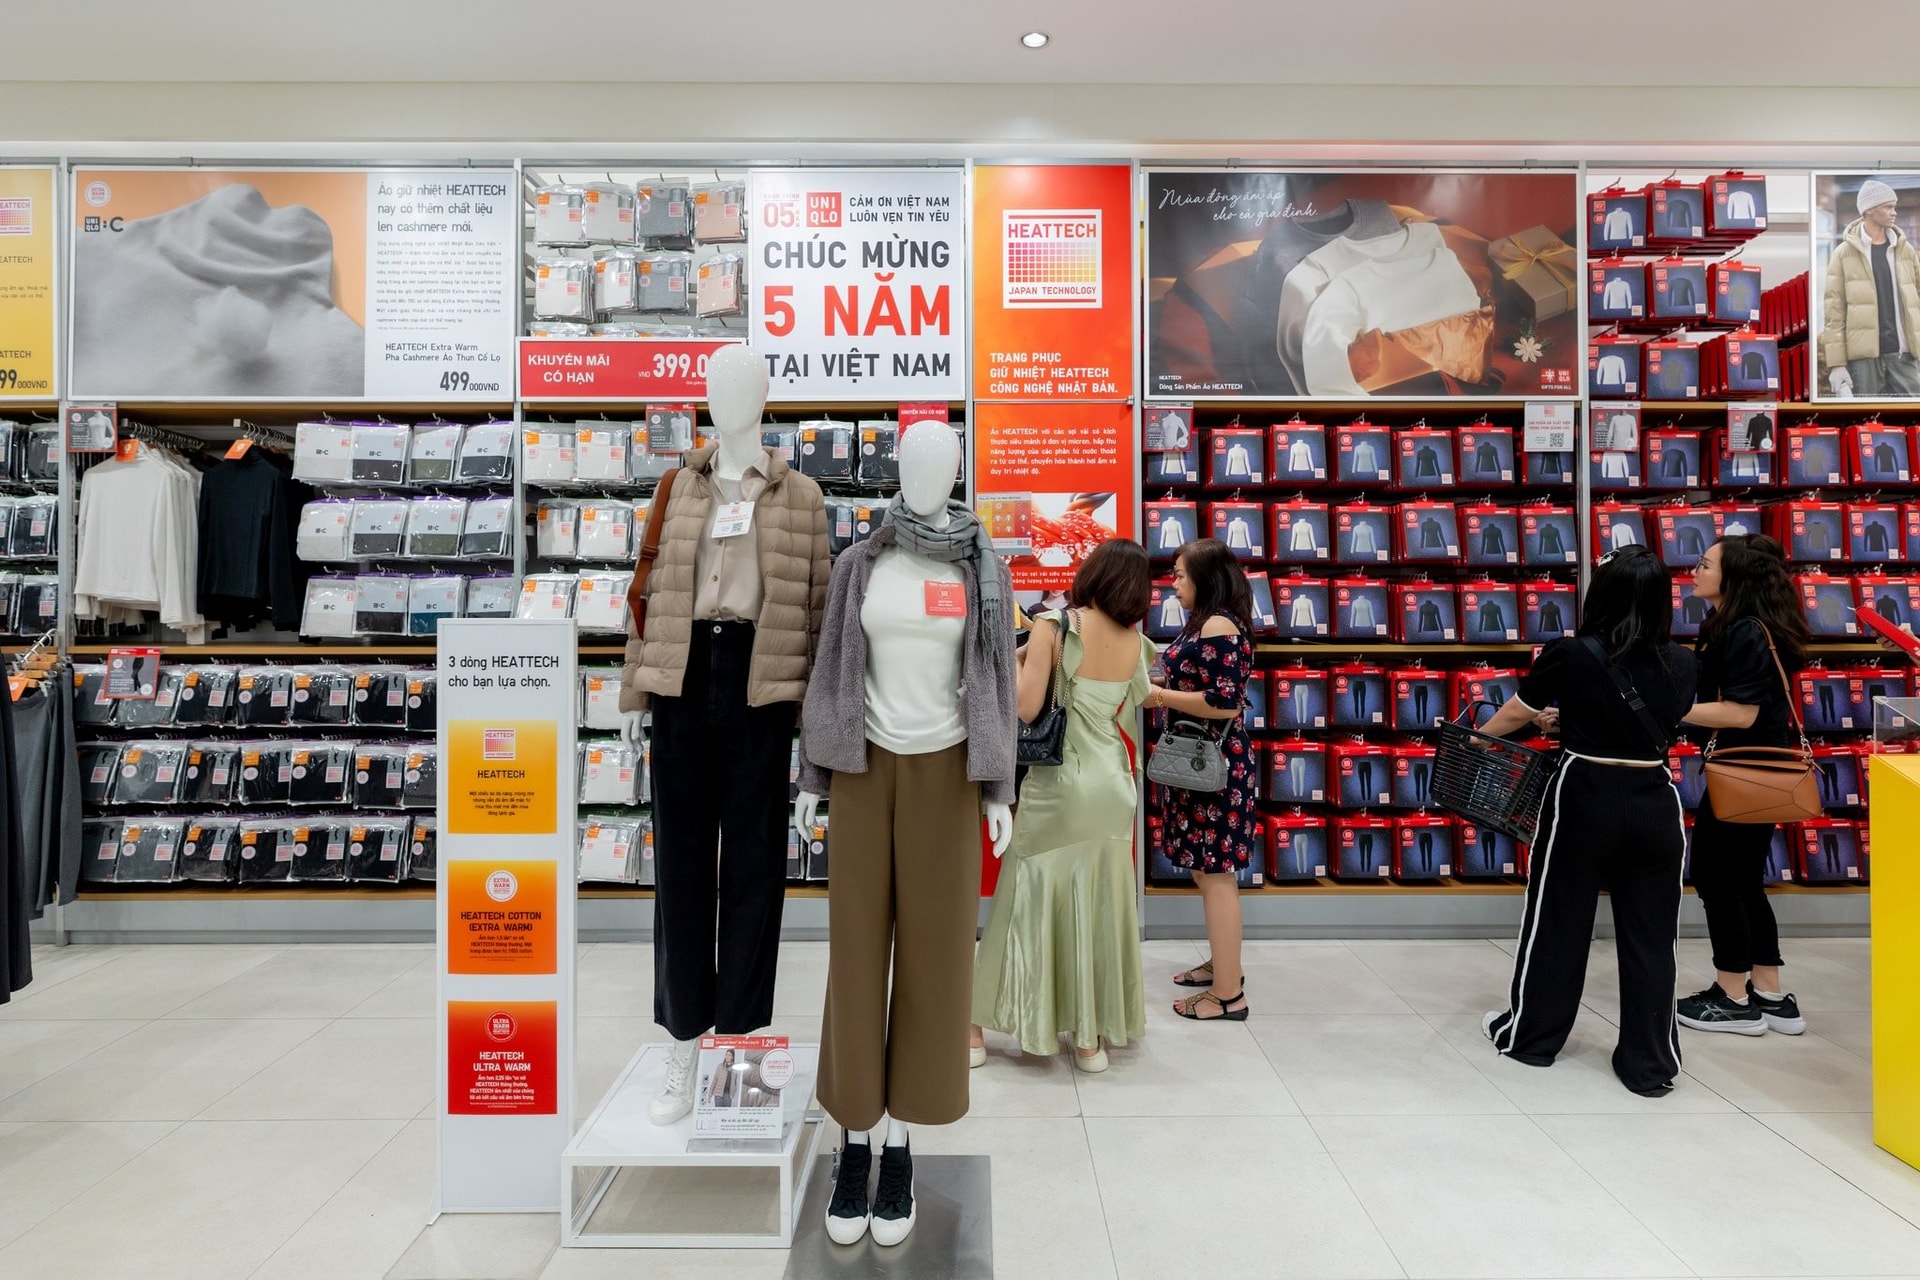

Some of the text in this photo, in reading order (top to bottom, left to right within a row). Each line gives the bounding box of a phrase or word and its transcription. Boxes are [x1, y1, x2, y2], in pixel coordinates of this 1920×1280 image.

[850, 194, 950, 209] CẢM ƠN VIỆT NAM
[764, 202, 795, 228] 05
[850, 210, 950, 224] LUÔN VẸN TIN YÊU
[1008, 224, 1097, 238] HEATTECH
[764, 233, 950, 269] CHÚC MỪNG
[1009, 287, 1097, 295] JAPAN TECHNOLOGY
[764, 272, 950, 337] 5 NĂM
[586, 353, 611, 366] MÃI
[765, 347, 950, 384] TẠI VIỆT NAM
[990, 353, 1061, 365] TRANG PHỤC
[544, 370, 595, 385] CÓ HẠN
[990, 365, 1109, 381] GIỮ NHIỆT HEATTECH
[990, 380, 1118, 395] CÔNG NGHỆ NHẬT BẢN.
[449, 656, 559, 671] 3 dòng HEATTECH
[448, 675, 550, 690] cho bạn lựa chọn.
[478, 770, 525, 779] HEATTECH
[461, 912, 542, 920] HEATTECH COTTON
[469, 924, 533, 932] (EXTRA WARM)
[480, 1052, 524, 1060] HEATTECH
[473, 1063, 531, 1072] ULTRA WARM
